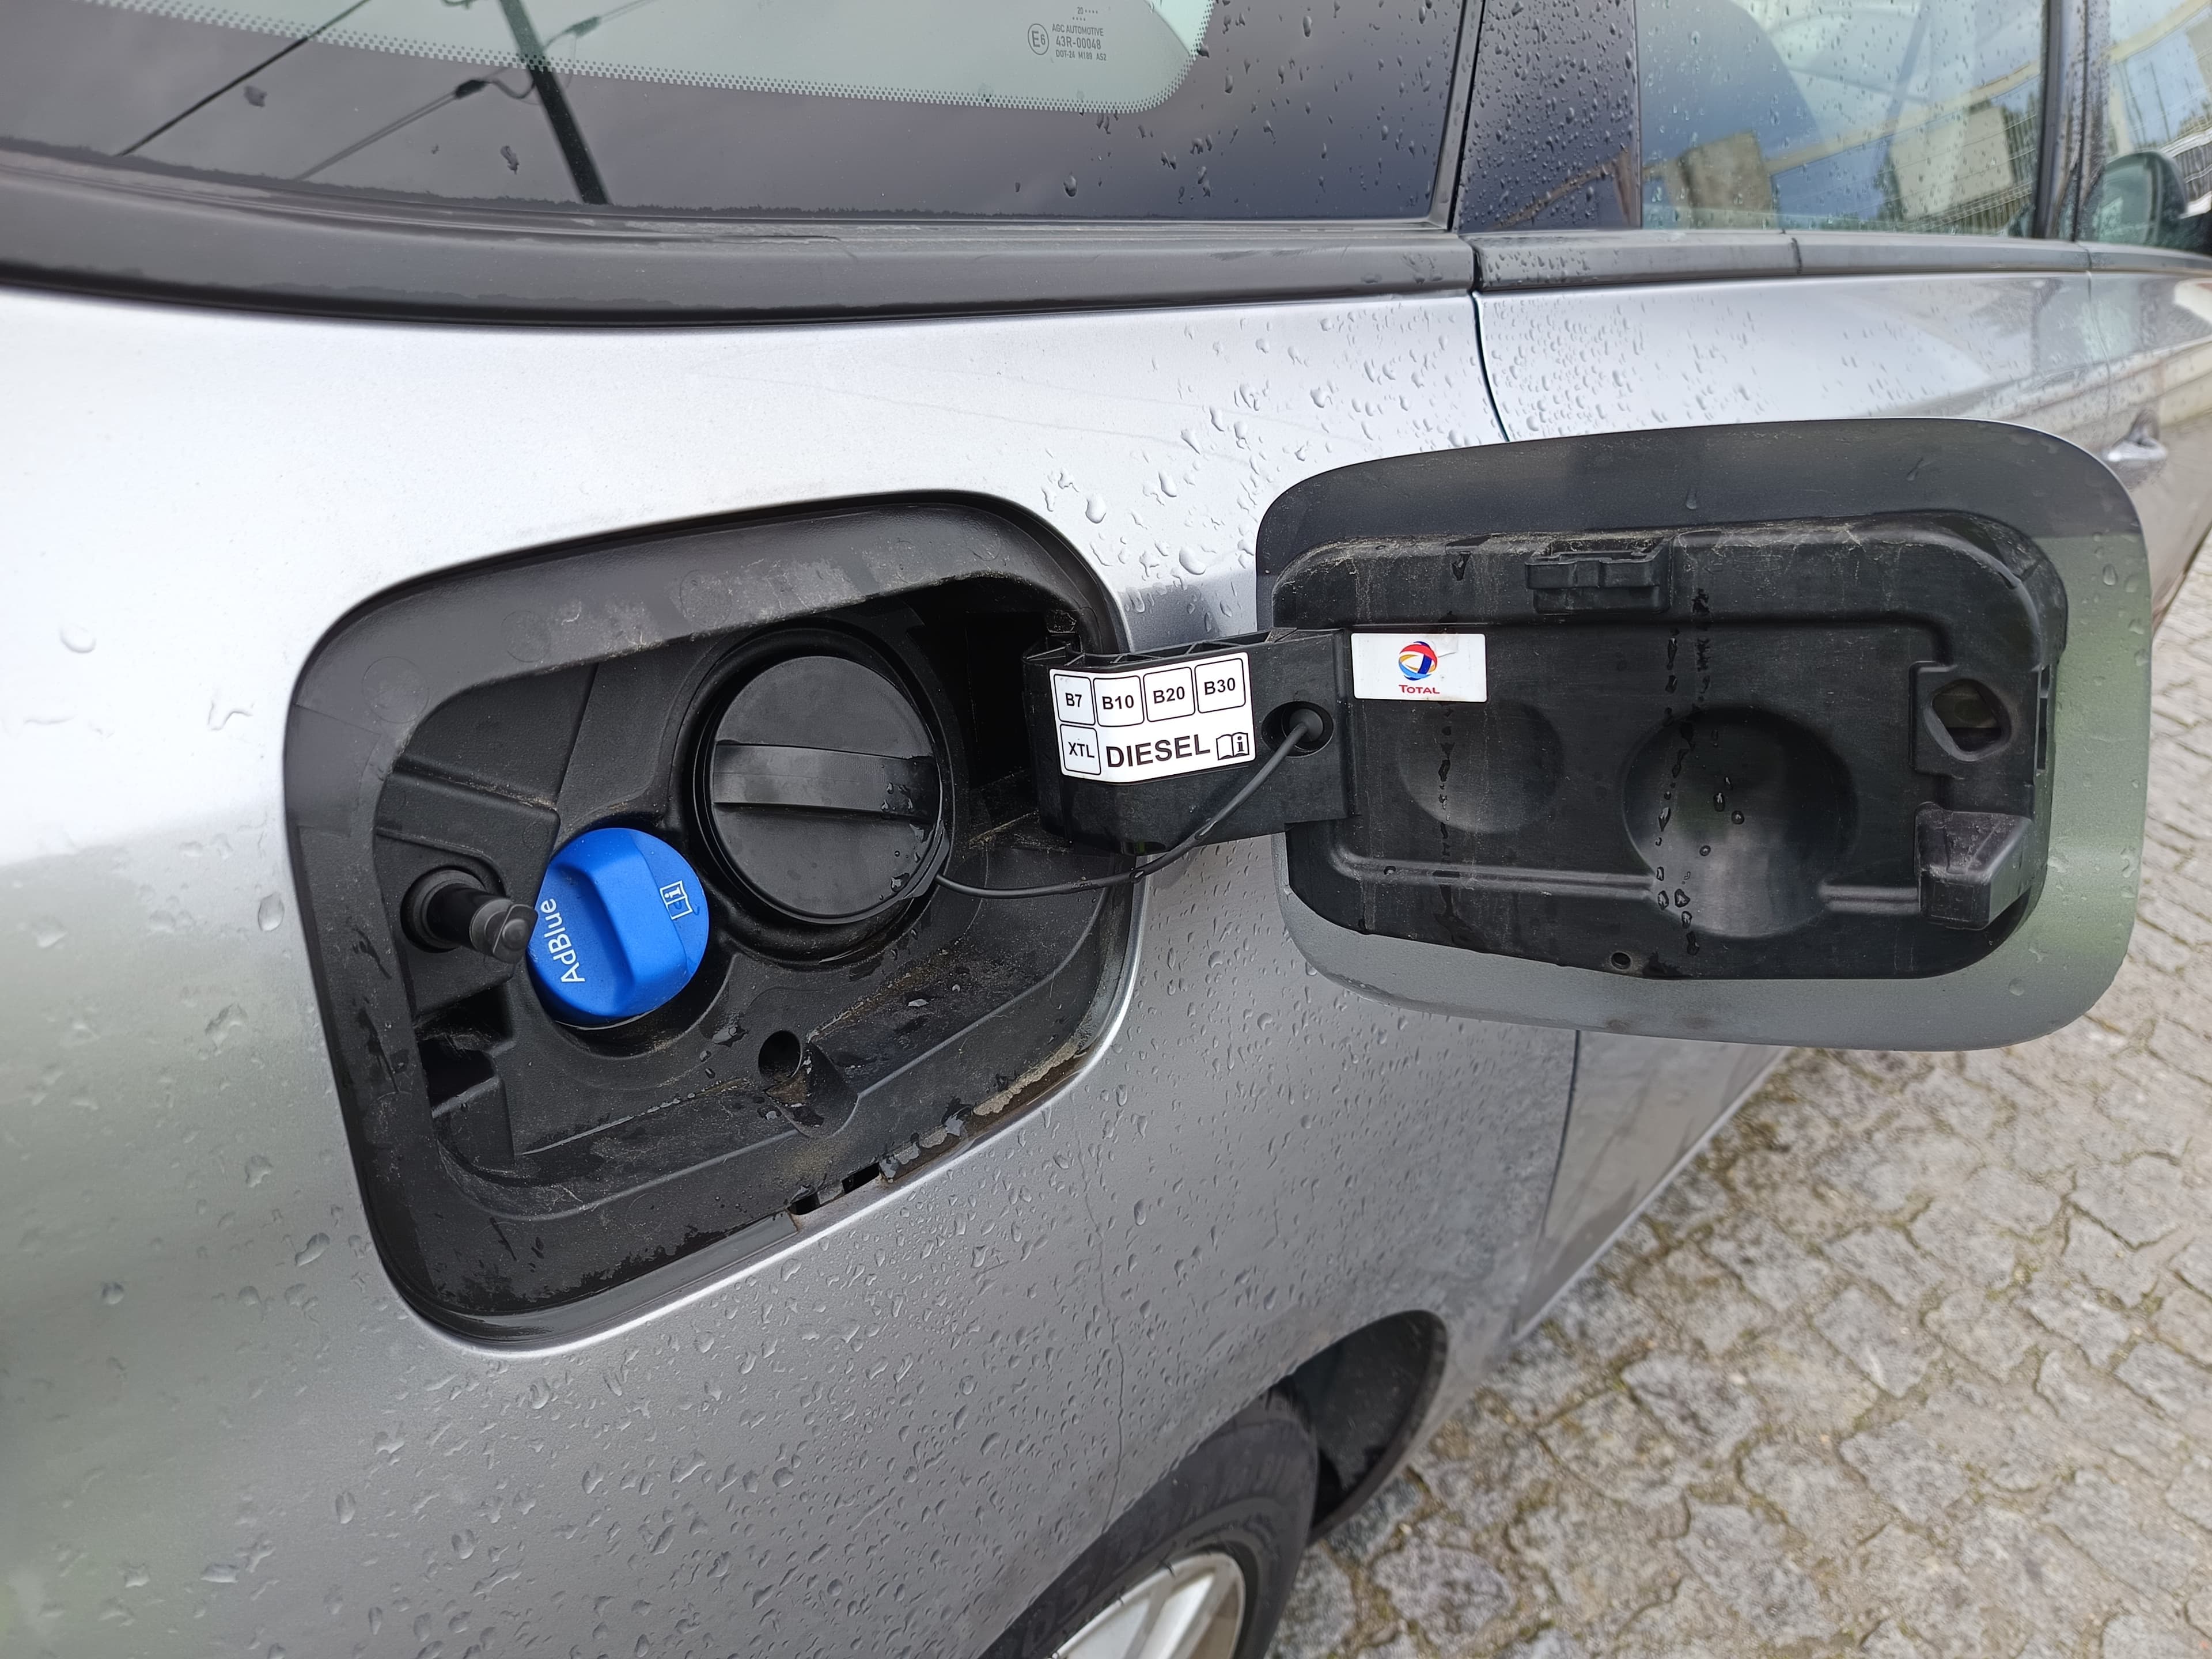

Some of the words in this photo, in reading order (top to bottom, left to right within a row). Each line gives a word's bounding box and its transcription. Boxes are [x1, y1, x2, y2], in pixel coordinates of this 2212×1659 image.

[1052, 24, 1065, 33] AGC
[1066, 24, 1104, 36] AUTOMOTIVE
[1056, 35, 1101, 50] 43R-00048
[1078, 51, 1092, 60] M189
[1096, 53, 1107, 61] AS2
[1065, 692, 1082, 707] B7
[1102, 695, 1134, 710] B10
[1153, 686, 1185, 704] B20
[1204, 677, 1236, 695] B30
[1068, 741, 1095, 759] XTL
[1106, 734, 1210, 768] DIESEL
[540, 898, 586, 982] AdBlue
